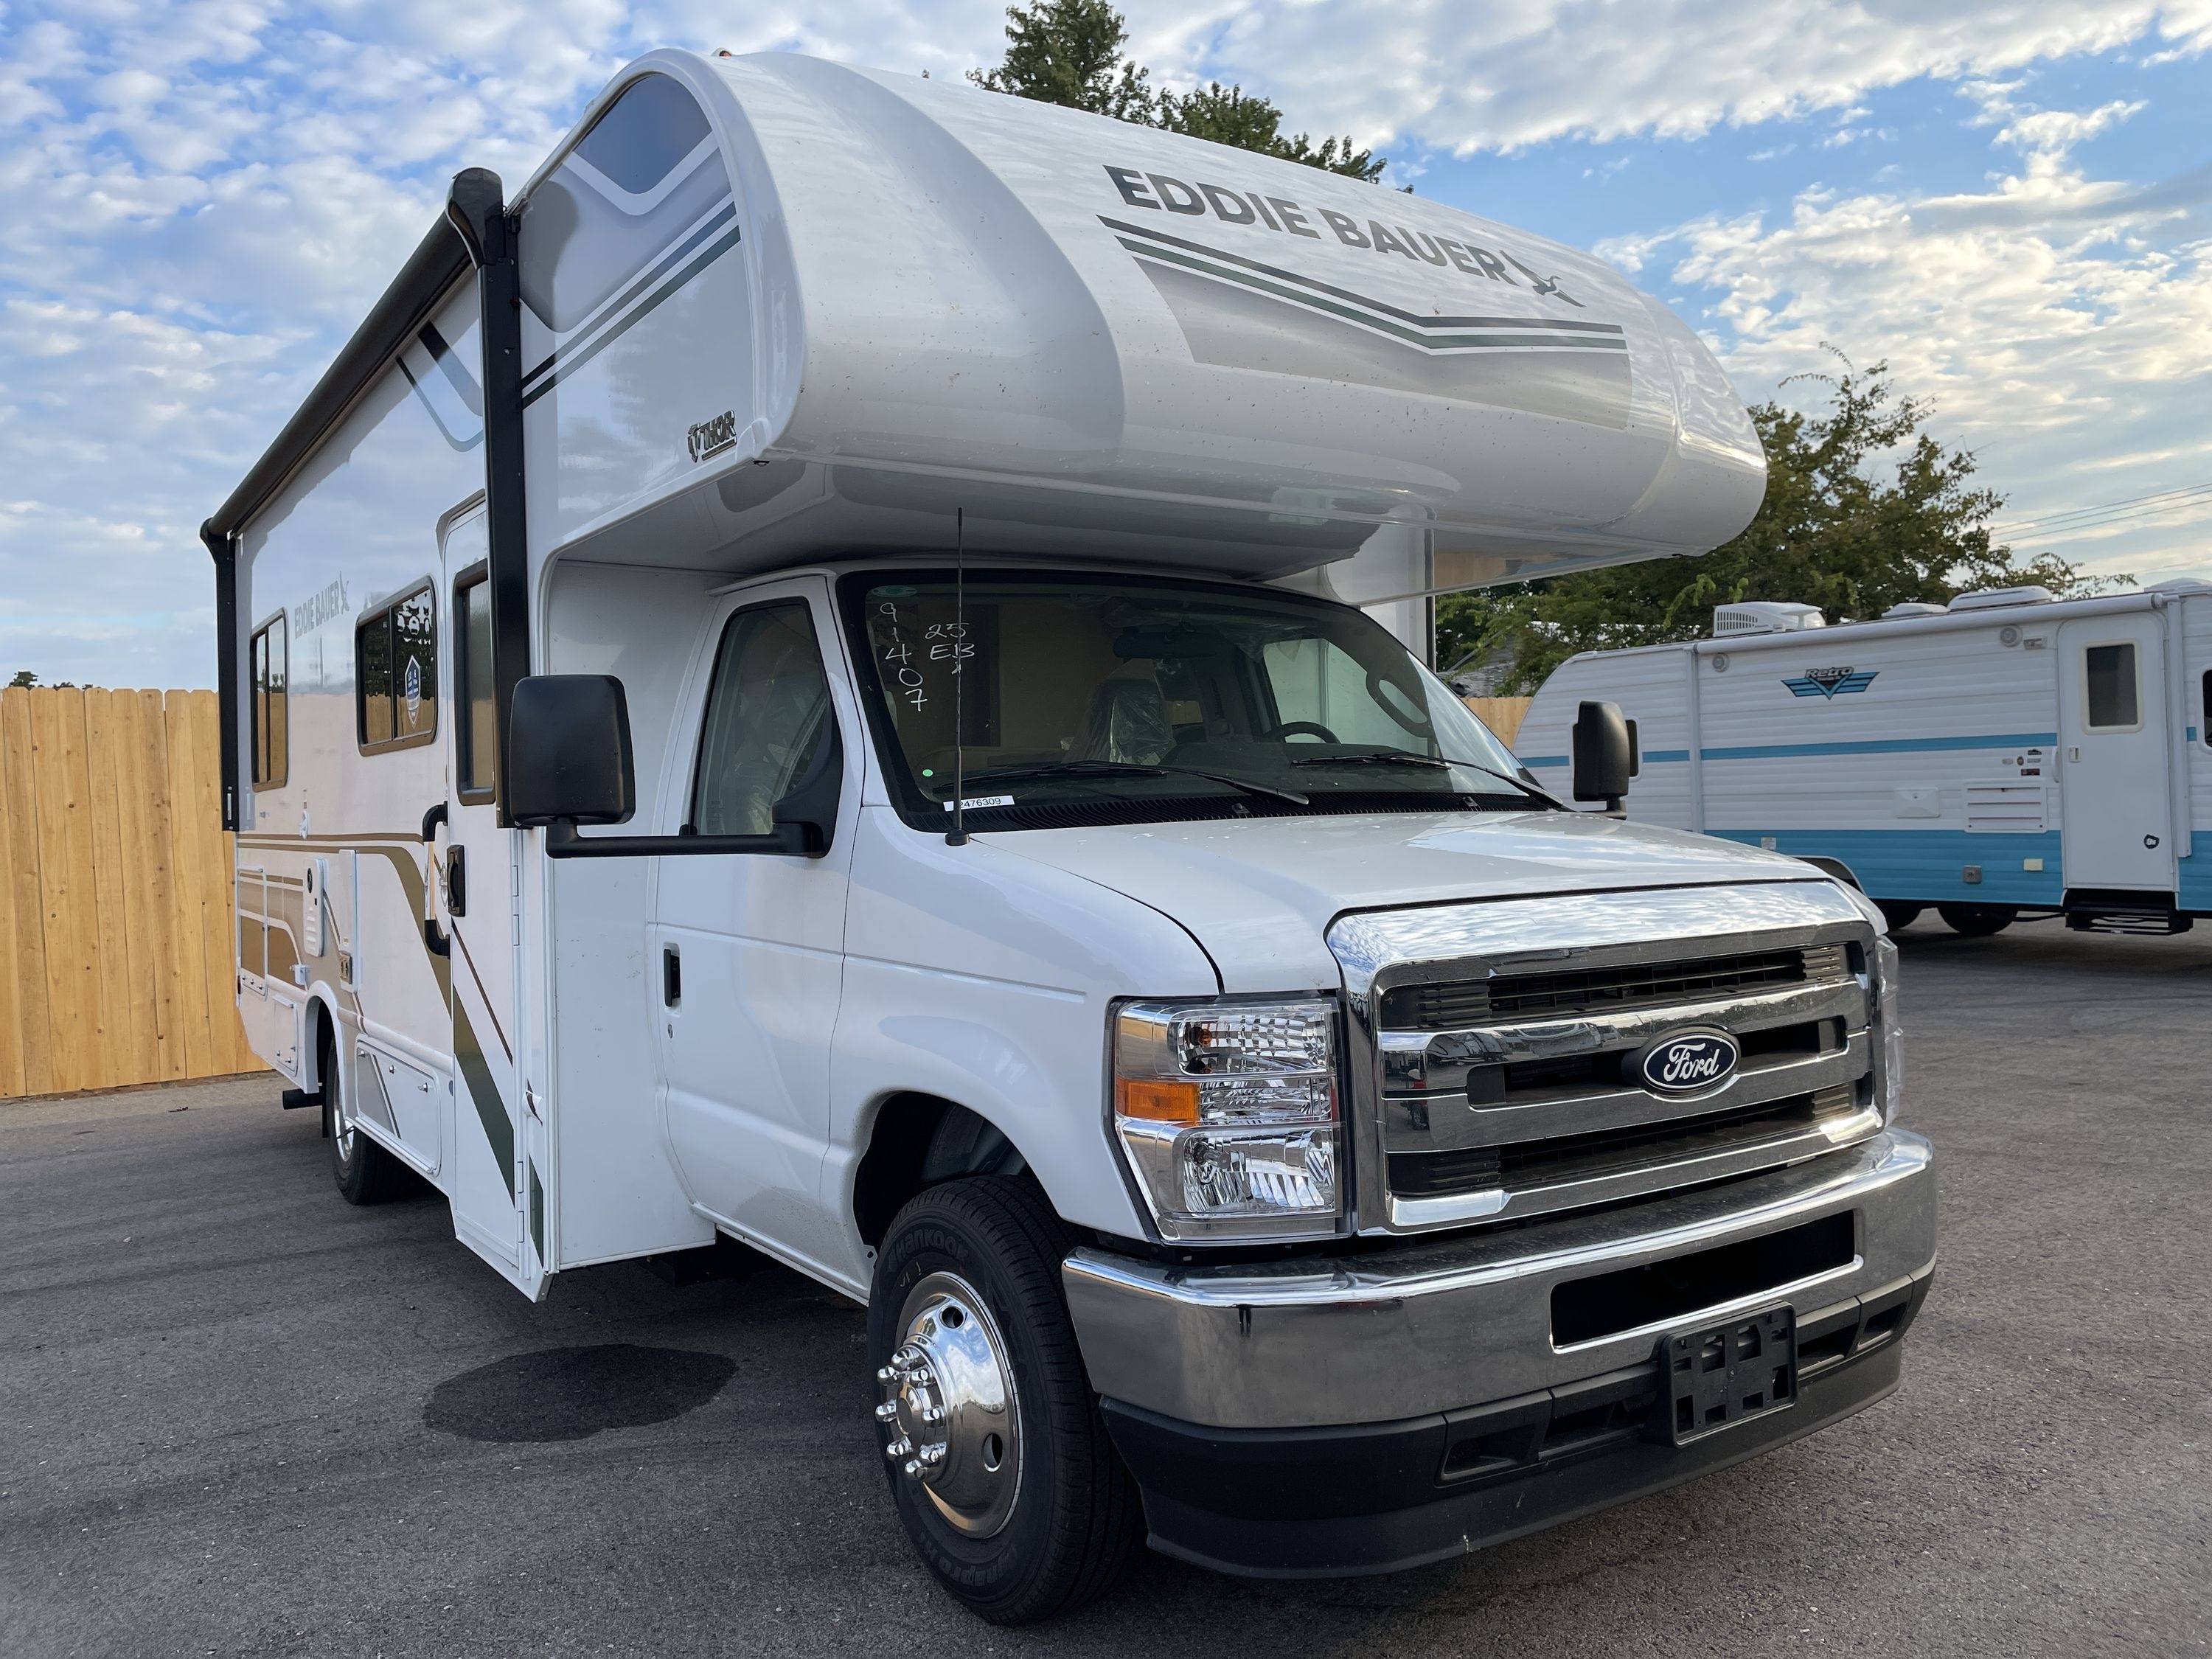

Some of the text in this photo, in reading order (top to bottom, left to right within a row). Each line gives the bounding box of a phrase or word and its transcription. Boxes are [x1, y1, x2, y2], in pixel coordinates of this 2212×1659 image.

[1103, 164, 1520, 287] EDDIE BAUER
[698, 410, 736, 451] THOR
[295, 580, 339, 640] EDDIE BAUER
[925, 623, 970, 639] 25
[930, 642, 975, 660] EB
[1805, 667, 1854, 679] Retro
[1663, 1043, 1720, 1082] Ford
